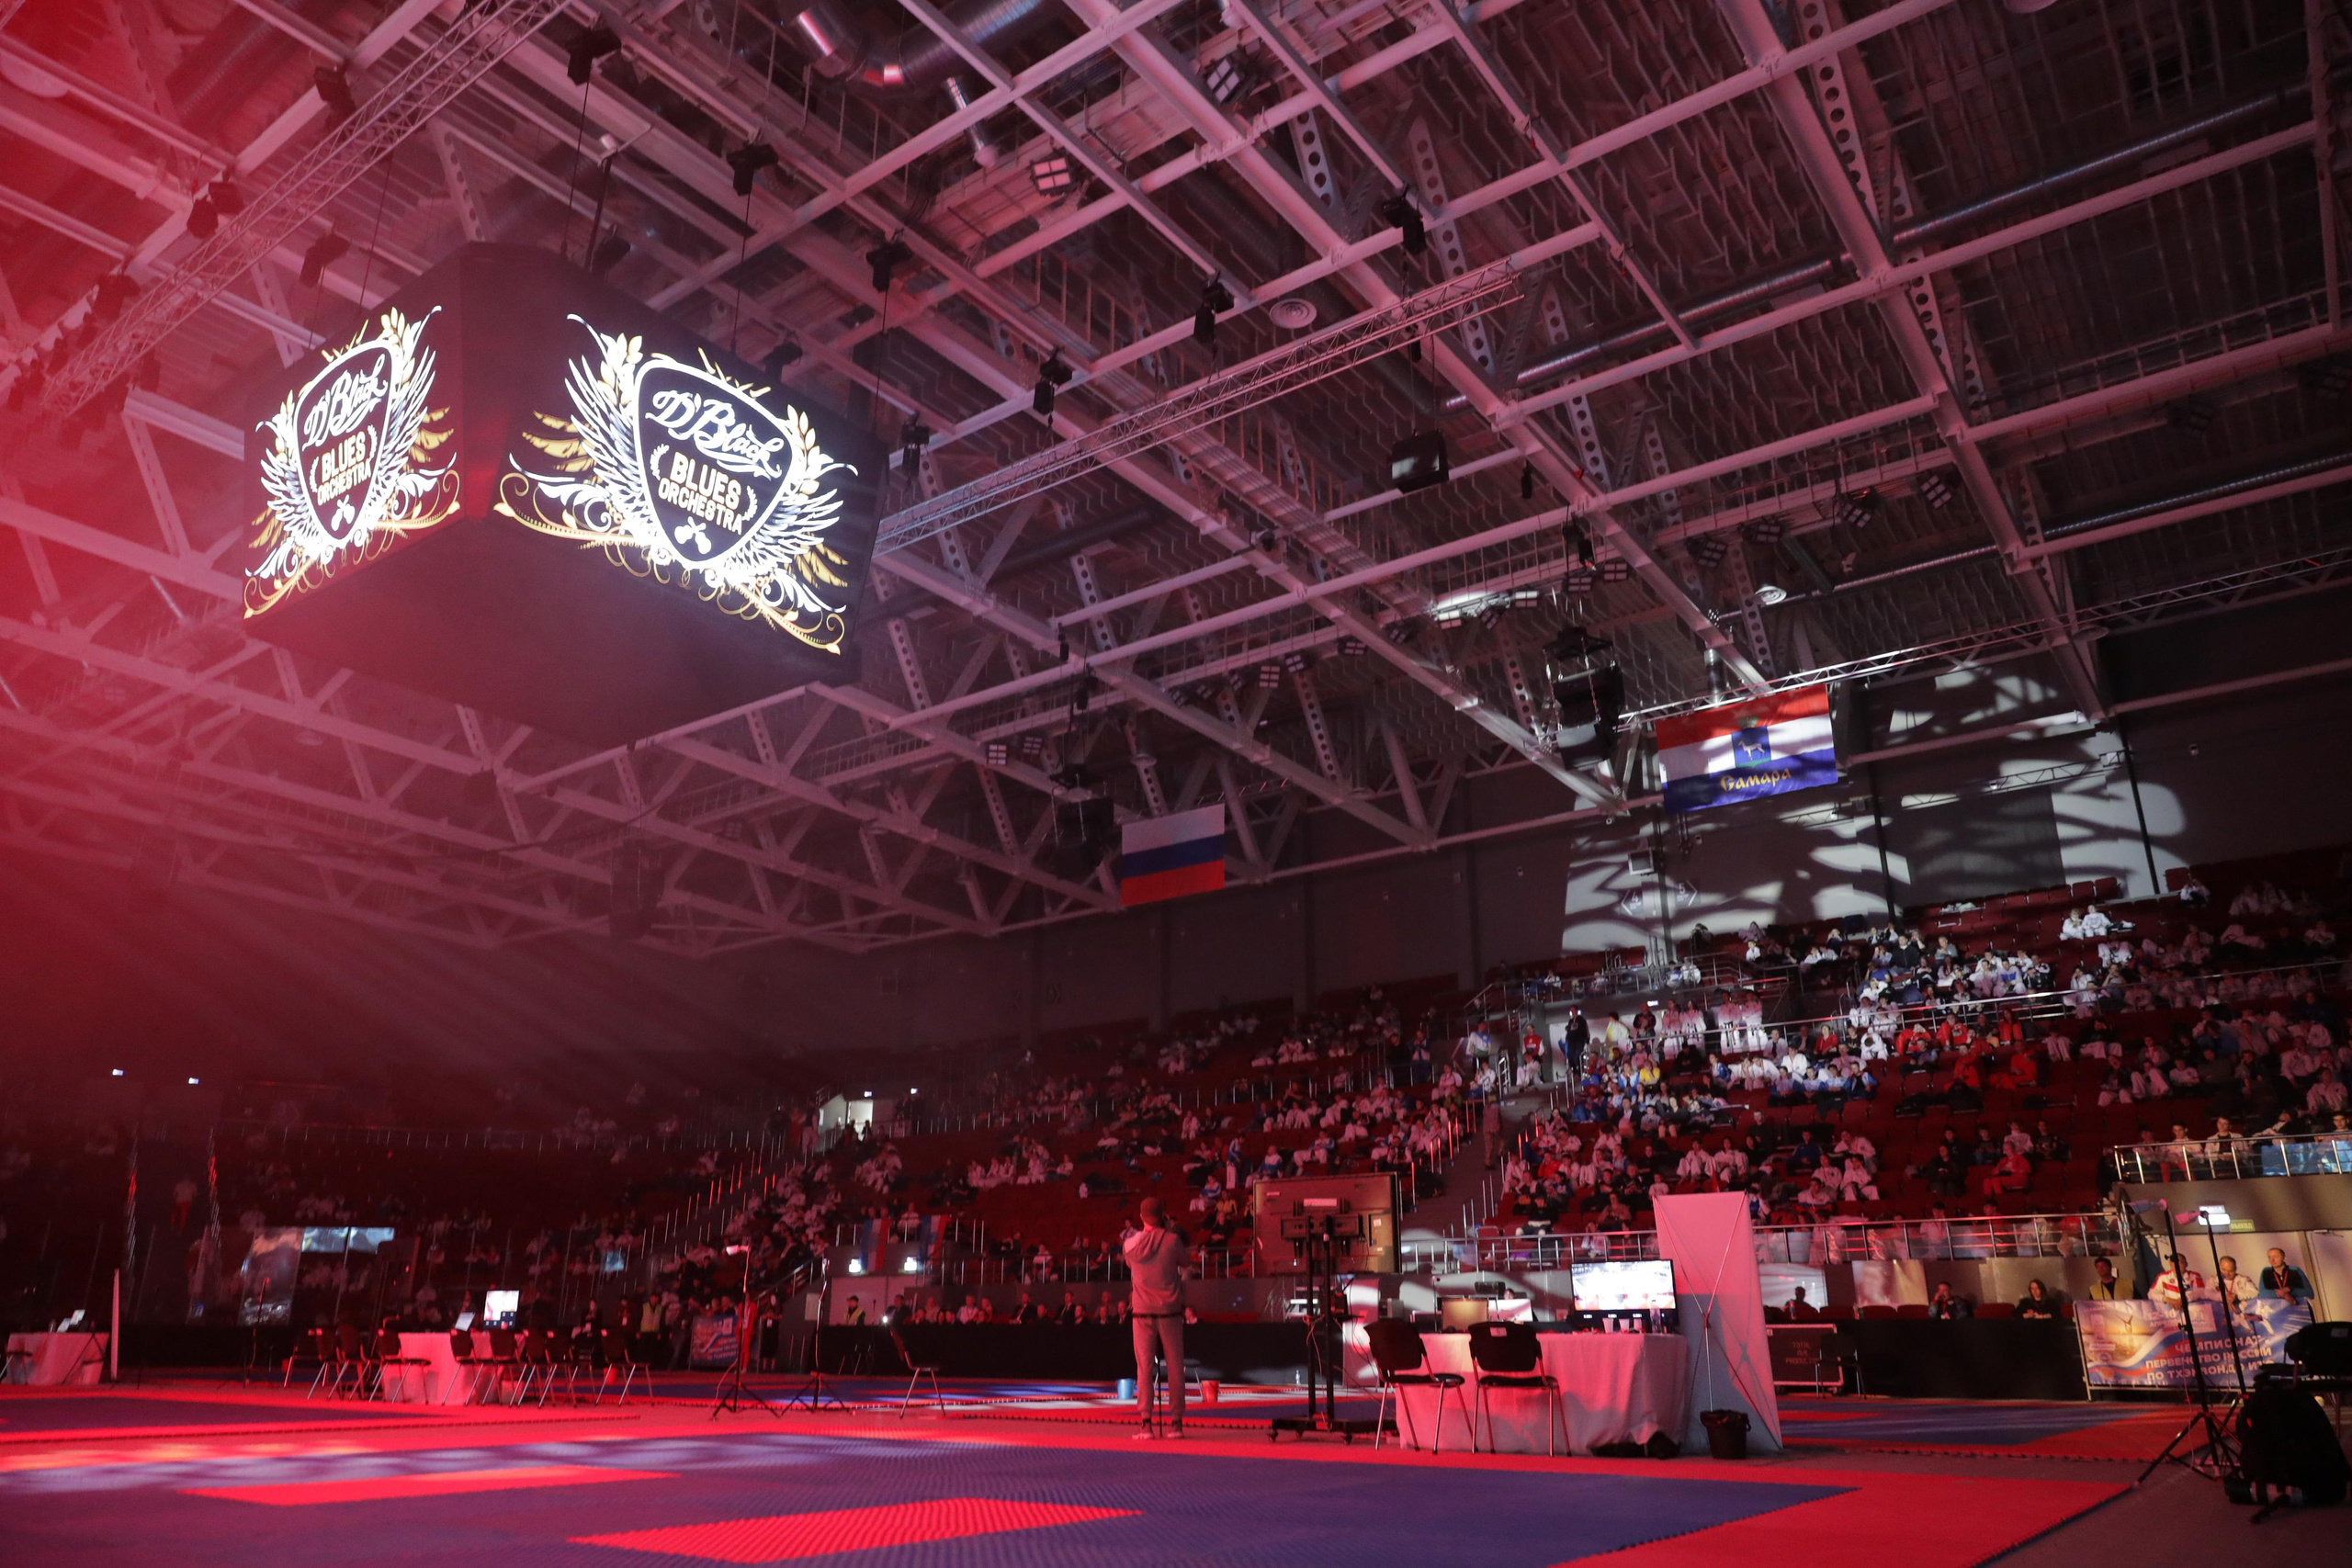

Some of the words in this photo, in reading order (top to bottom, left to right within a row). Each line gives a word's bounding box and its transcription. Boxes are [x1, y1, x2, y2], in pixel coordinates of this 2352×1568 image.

[321, 430, 367, 479] BLUES
[317, 459, 371, 507] ORCHESTRA
[669, 452, 741, 509] BLUES
[658, 478, 743, 536] ORCHESTRA
[1721, 768, 1792, 792] Самара
[2146, 1371, 2165, 1382] ПО
